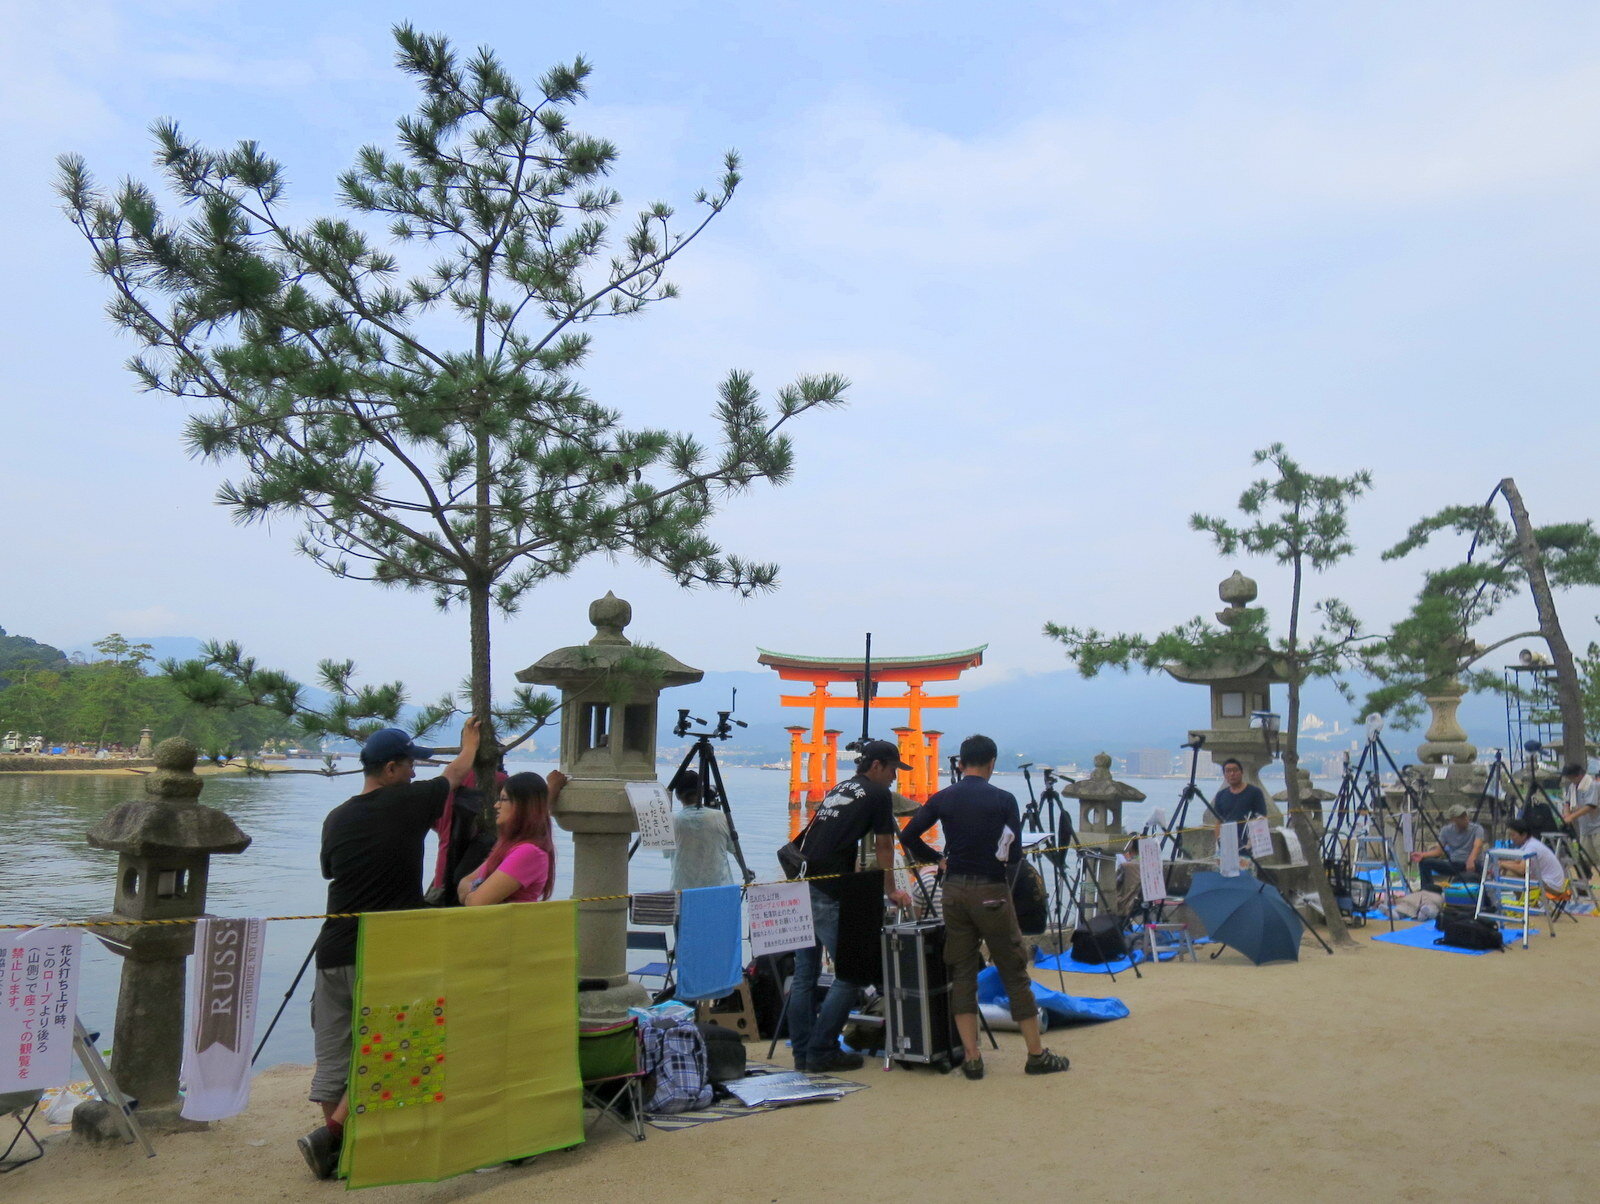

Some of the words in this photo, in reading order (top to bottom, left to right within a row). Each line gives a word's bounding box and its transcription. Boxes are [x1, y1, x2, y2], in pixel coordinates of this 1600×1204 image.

[8, 947, 25, 1013] 禁止します。
[54, 944, 73, 1030] 花火打ち上げ時、
[248, 946, 257, 962] NEW
